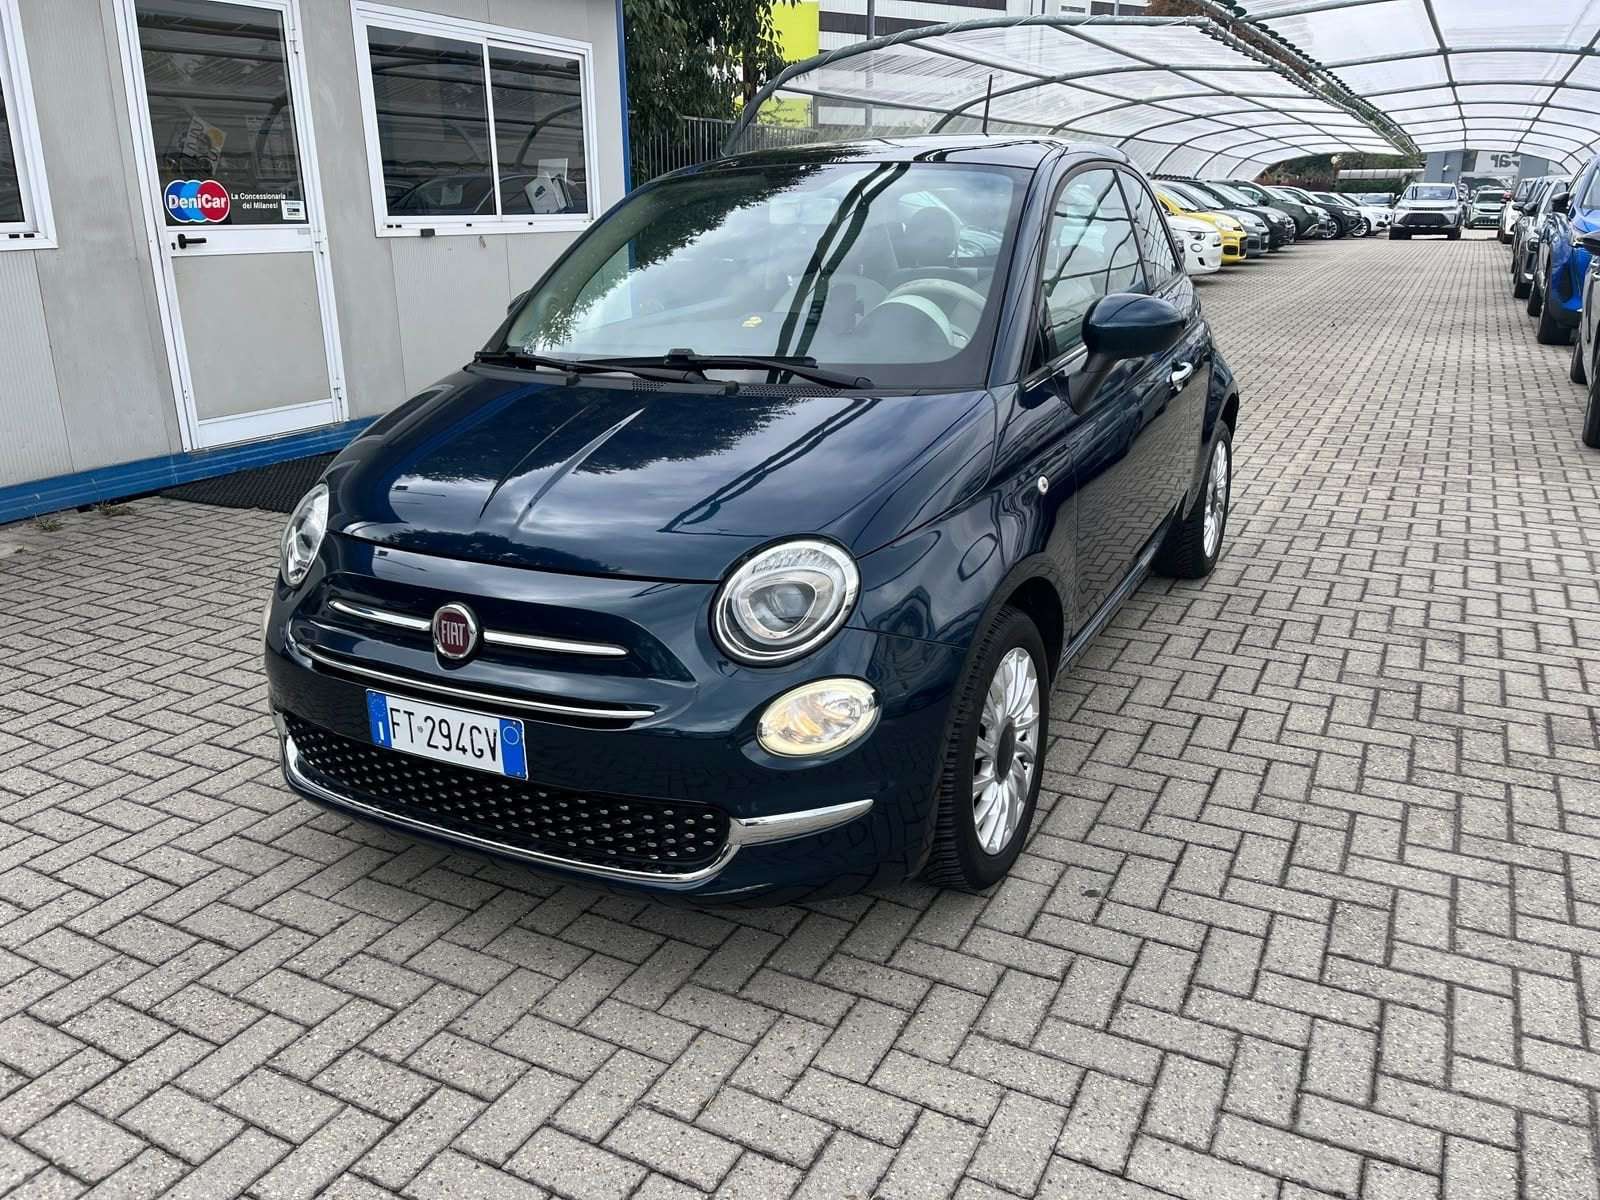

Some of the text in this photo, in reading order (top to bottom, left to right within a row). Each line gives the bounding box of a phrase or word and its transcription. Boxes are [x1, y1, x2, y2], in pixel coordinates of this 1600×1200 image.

[168, 193, 227, 209] DeniCar
[231, 192, 286, 200] La Concessionaria
[253, 201, 278, 209] Milanesi
[441, 620, 466, 646] FIAT
[389, 707, 498, 762] FT 294GV
